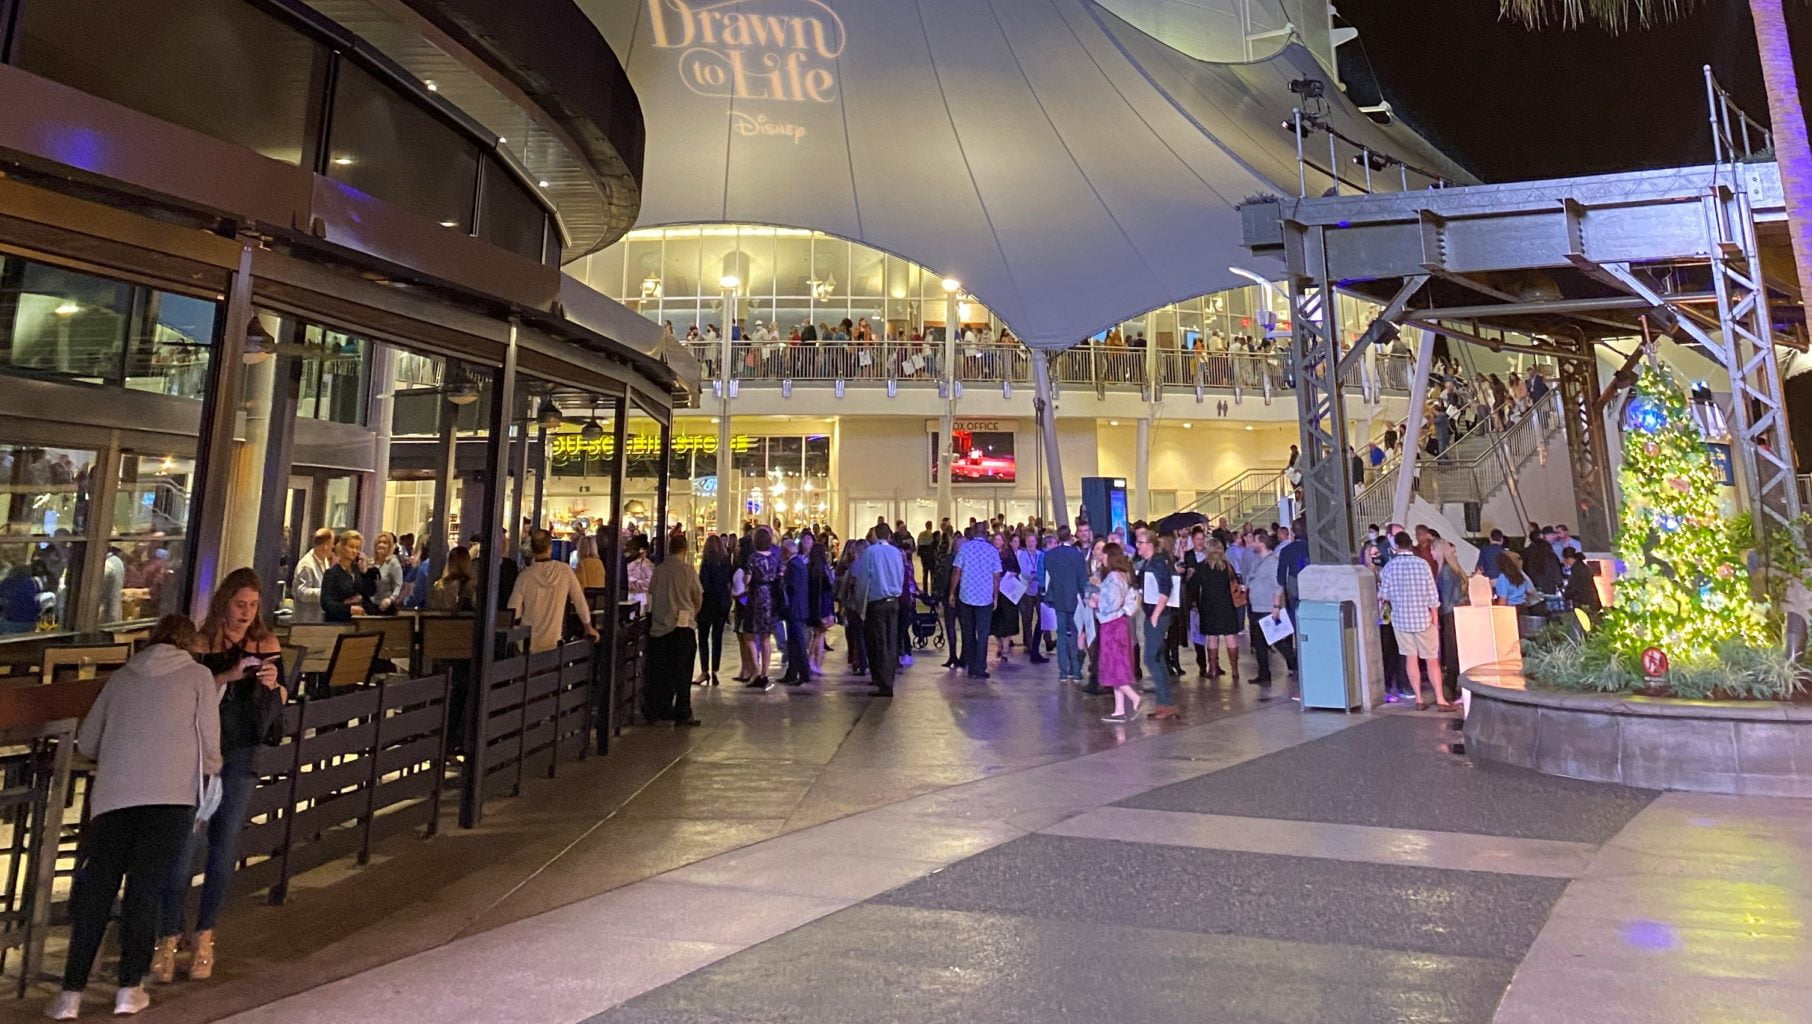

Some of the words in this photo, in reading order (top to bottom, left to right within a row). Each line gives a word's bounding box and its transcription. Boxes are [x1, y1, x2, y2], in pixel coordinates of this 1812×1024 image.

[691, 60, 726, 86] to
[724, 48, 837, 104] Life
[967, 422, 999, 431] OFFICE
[586, 435, 662, 455] SOEIL
[674, 434, 749, 454] STOE
